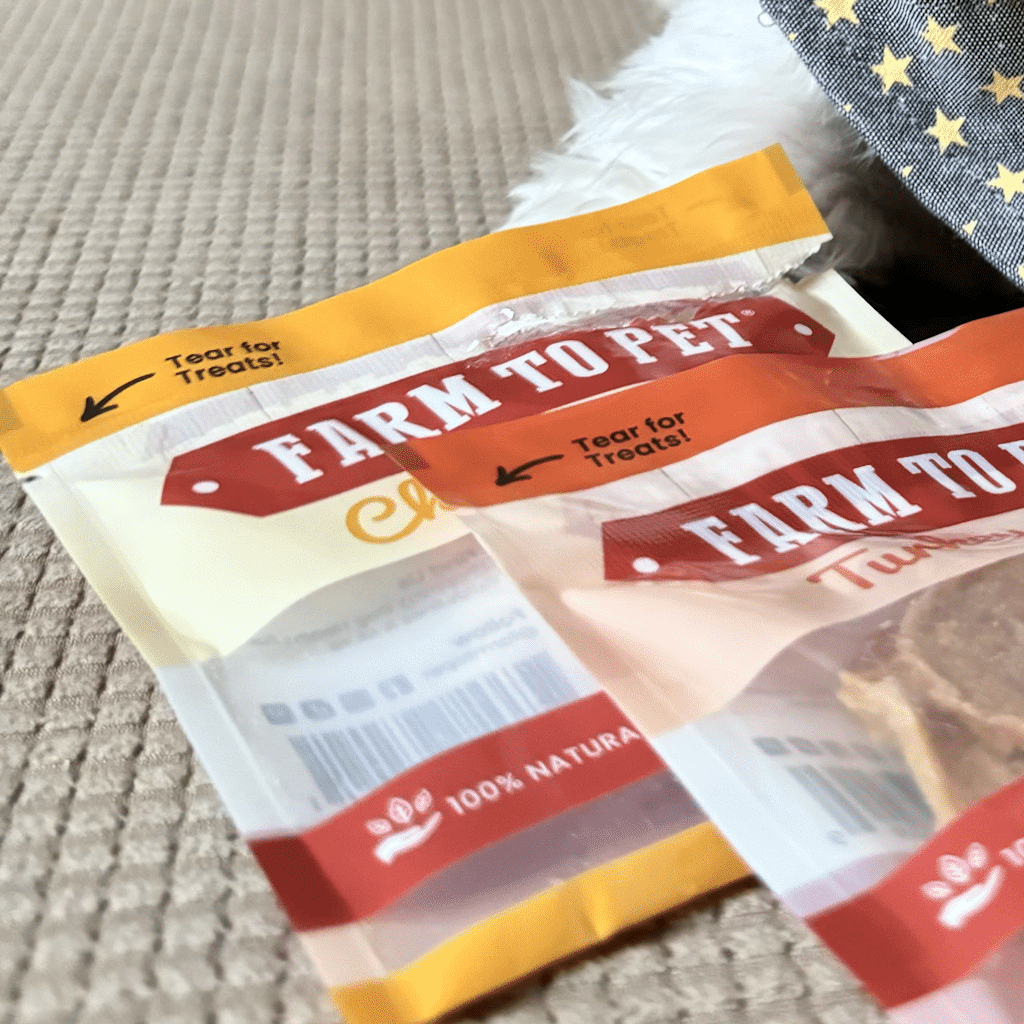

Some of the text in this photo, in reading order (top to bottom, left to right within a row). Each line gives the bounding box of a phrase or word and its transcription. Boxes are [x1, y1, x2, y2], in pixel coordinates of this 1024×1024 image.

[165, 338, 282, 371] Tear for
[175, 352, 284, 386] Treats!
[253, 373, 502, 484] FARM
[493, 339, 610, 393] TO
[571, 412, 686, 453] Tear for
[584, 429, 692, 468] Treats!
[680, 464, 922, 566] FARM
[896, 449, 1018, 499] TO
[445, 726, 641, 816] 100% NATURA
